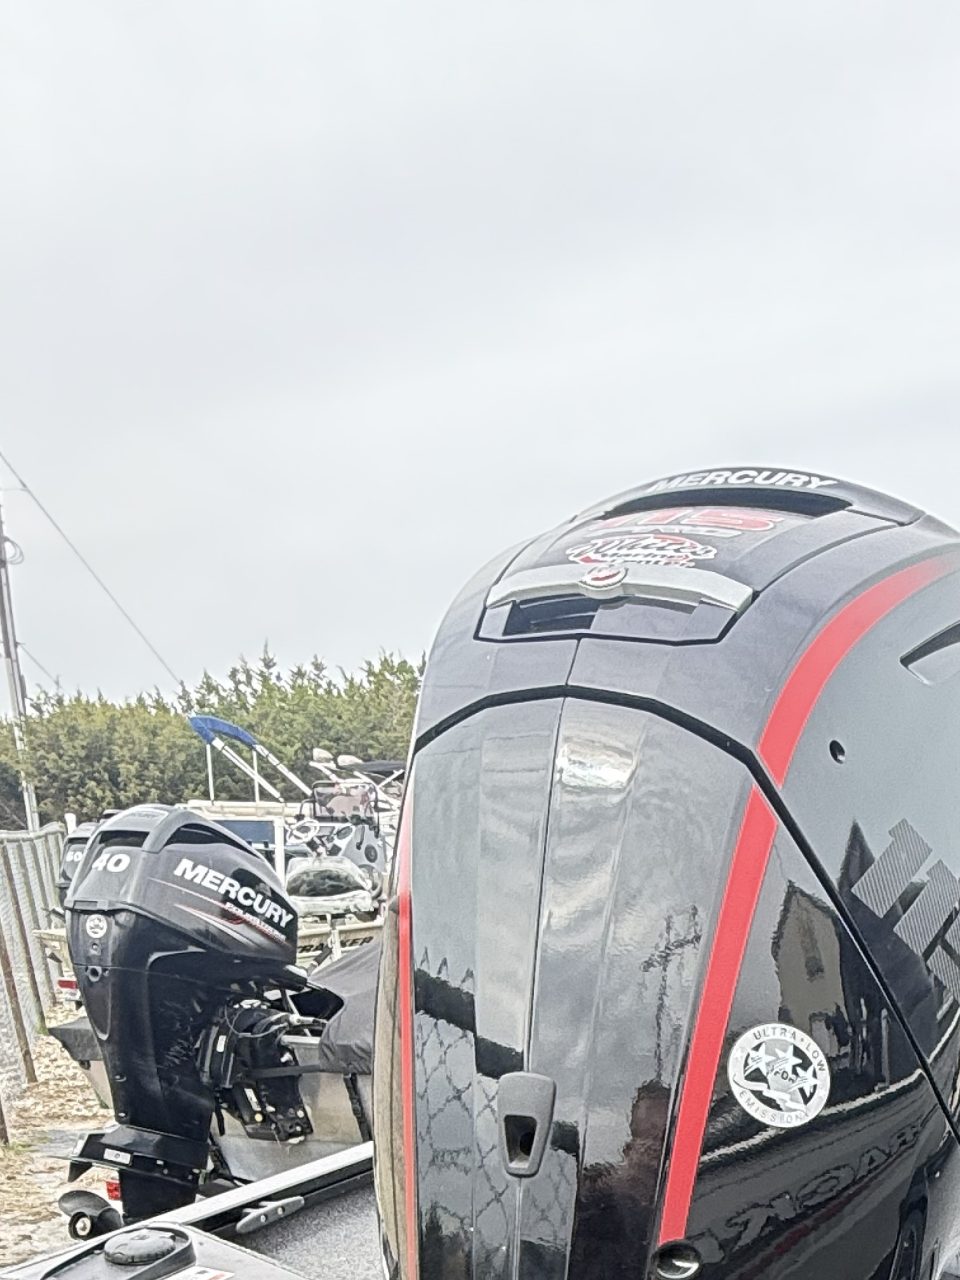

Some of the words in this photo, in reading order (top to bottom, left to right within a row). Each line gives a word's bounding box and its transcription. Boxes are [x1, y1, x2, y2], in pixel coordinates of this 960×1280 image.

[647, 470, 838, 492] MERCURY
[92, 854, 130, 873] 40
[173, 857, 294, 928] MERCURY
[752, 1027, 797, 1041] ULTRA
